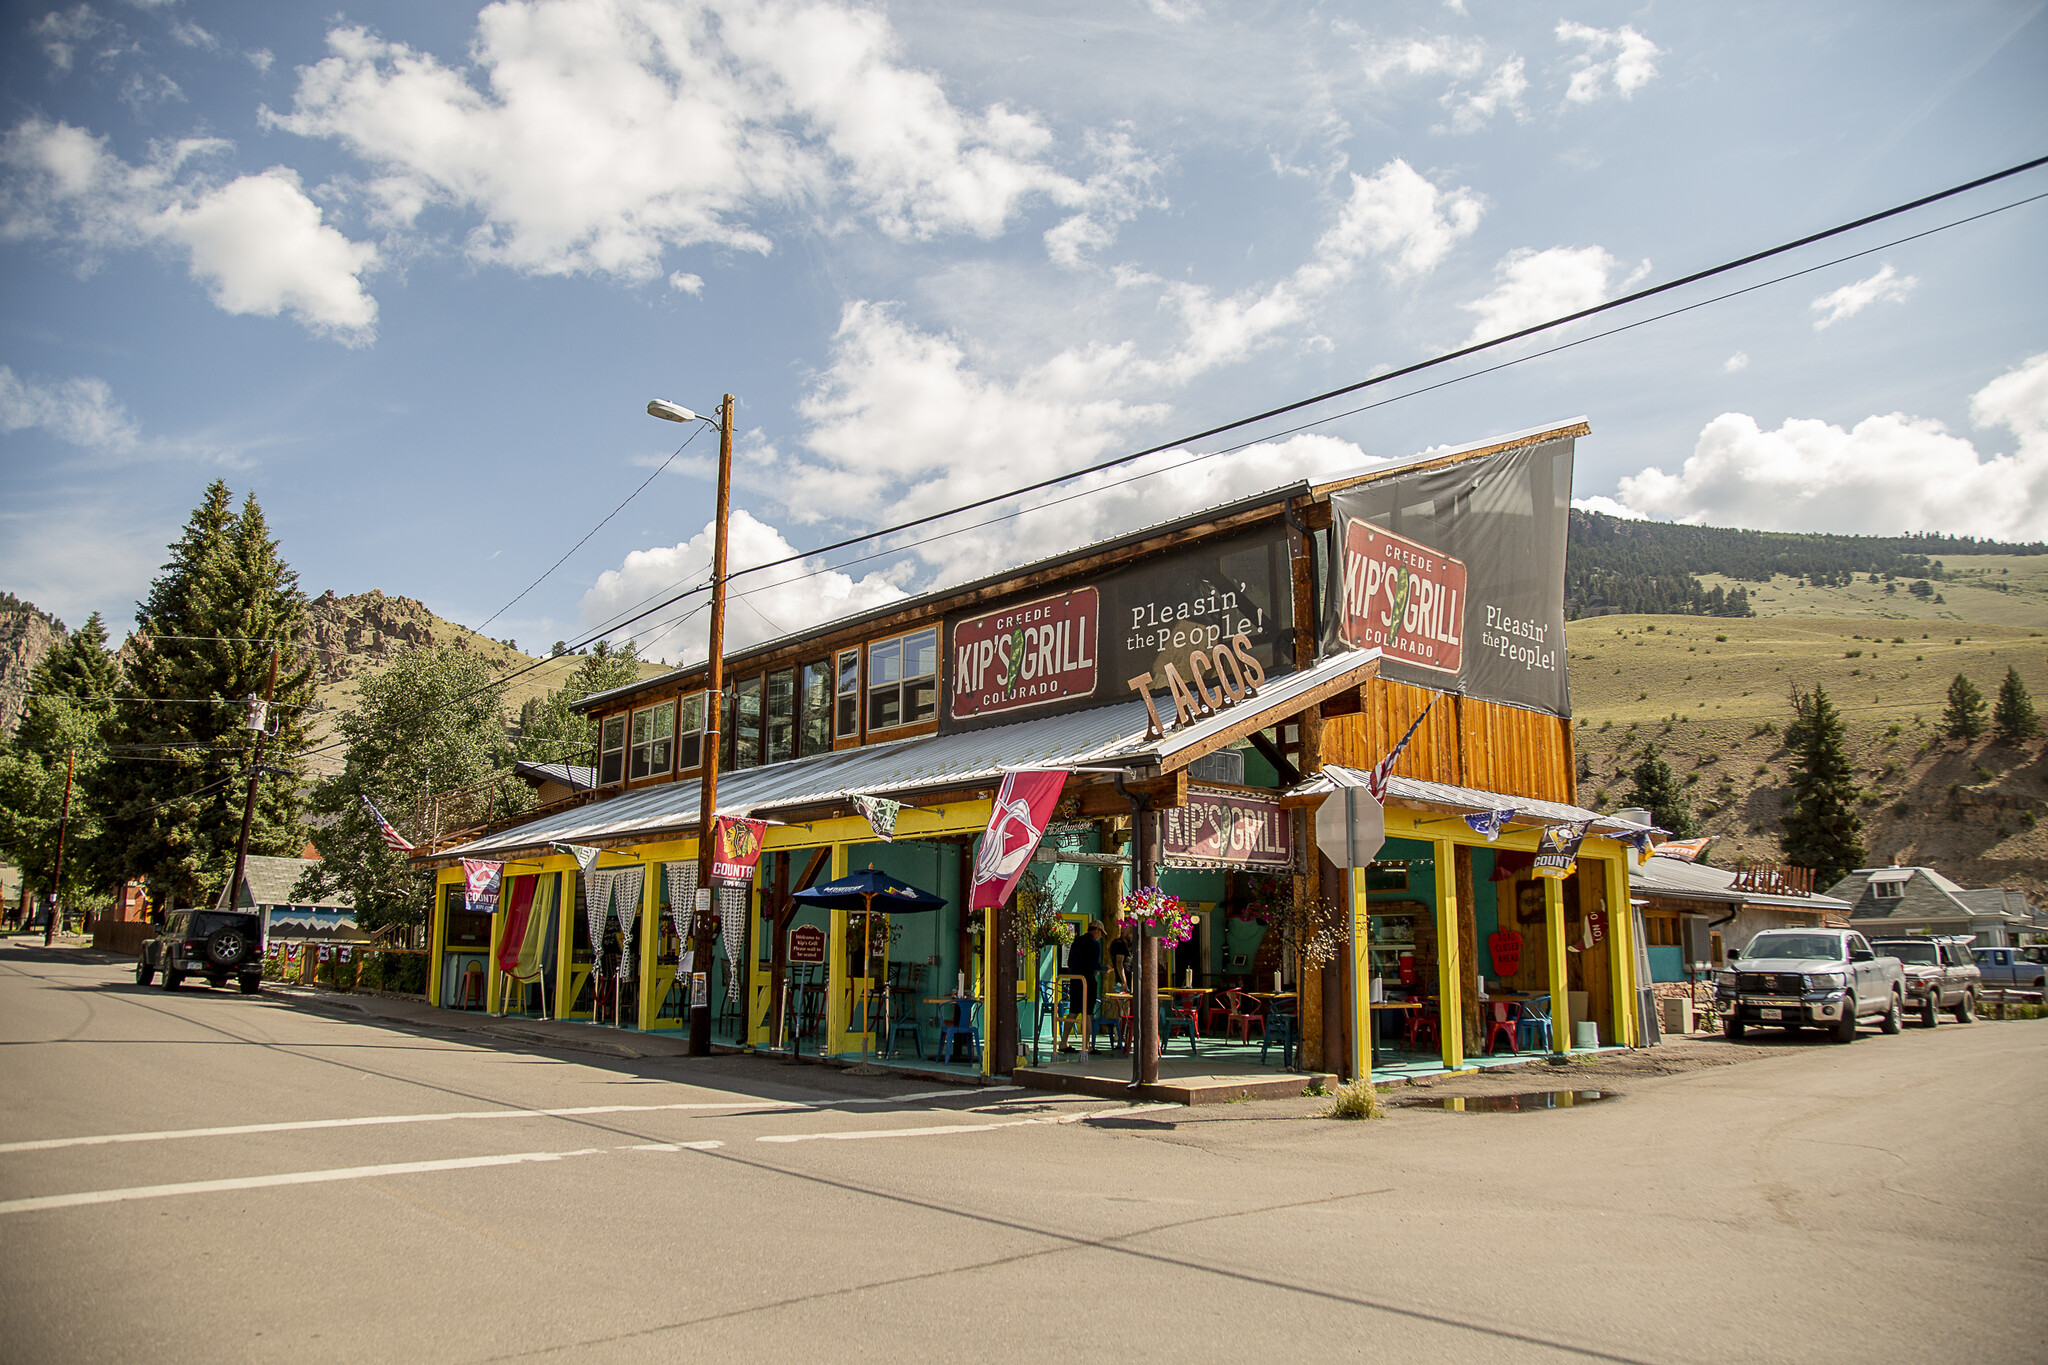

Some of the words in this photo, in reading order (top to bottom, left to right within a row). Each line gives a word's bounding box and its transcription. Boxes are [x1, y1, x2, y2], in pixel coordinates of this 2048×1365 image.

[1385, 544, 1433, 573] CREEDE
[1131, 581, 1247, 630] Pleasin'
[1344, 550, 1399, 627] KIP'S
[1403, 573, 1459, 646] GRILL
[996, 606, 1051, 630] CREEDE
[1126, 633, 1155, 651] the
[1156, 607, 1263, 652] People!
[1486, 604, 1548, 643] Pleasin'
[956, 632, 1013, 695] KIP'S
[1020, 615, 1093, 681] GRILL
[1365, 628, 1433, 659] COLORADO
[1482, 631, 1500, 648] the
[1499, 635, 1555, 672] People!
[983, 680, 1059, 706] COLORADO
[1127, 633, 1266, 735] TACOS
[1189, 753, 1240, 783] OPEN
[1168, 802, 1222, 849] KIP'S
[1230, 806, 1287, 854] GRILL
[1533, 854, 1575, 869] COUNT
[1495, 942, 1520, 953] CLOSED
